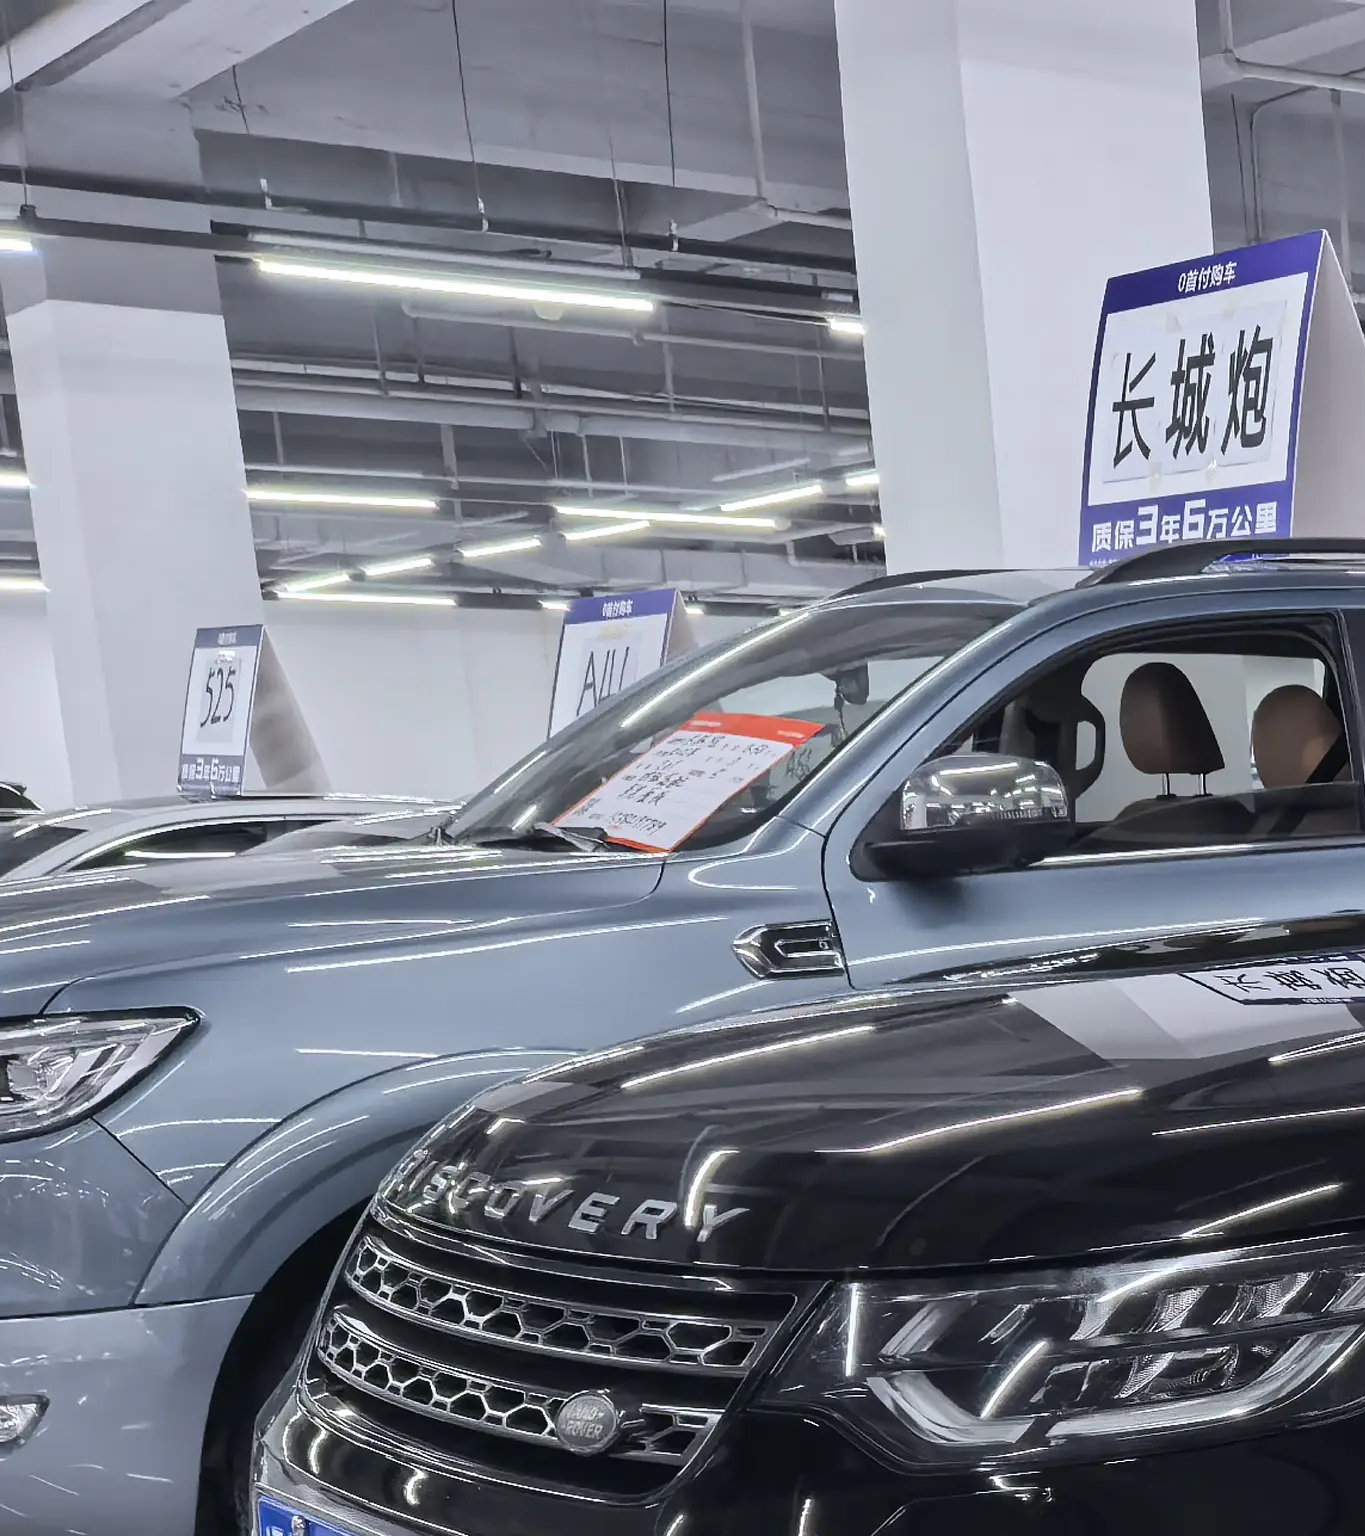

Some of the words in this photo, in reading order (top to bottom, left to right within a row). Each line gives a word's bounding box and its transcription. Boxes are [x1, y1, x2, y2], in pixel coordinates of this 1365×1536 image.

[1178, 261, 1237, 293] 0首付购车
[1112, 324, 1274, 469] 长城炮
[1091, 498, 1277, 553] 质保3年6万公里
[200, 665, 236, 728] 525
